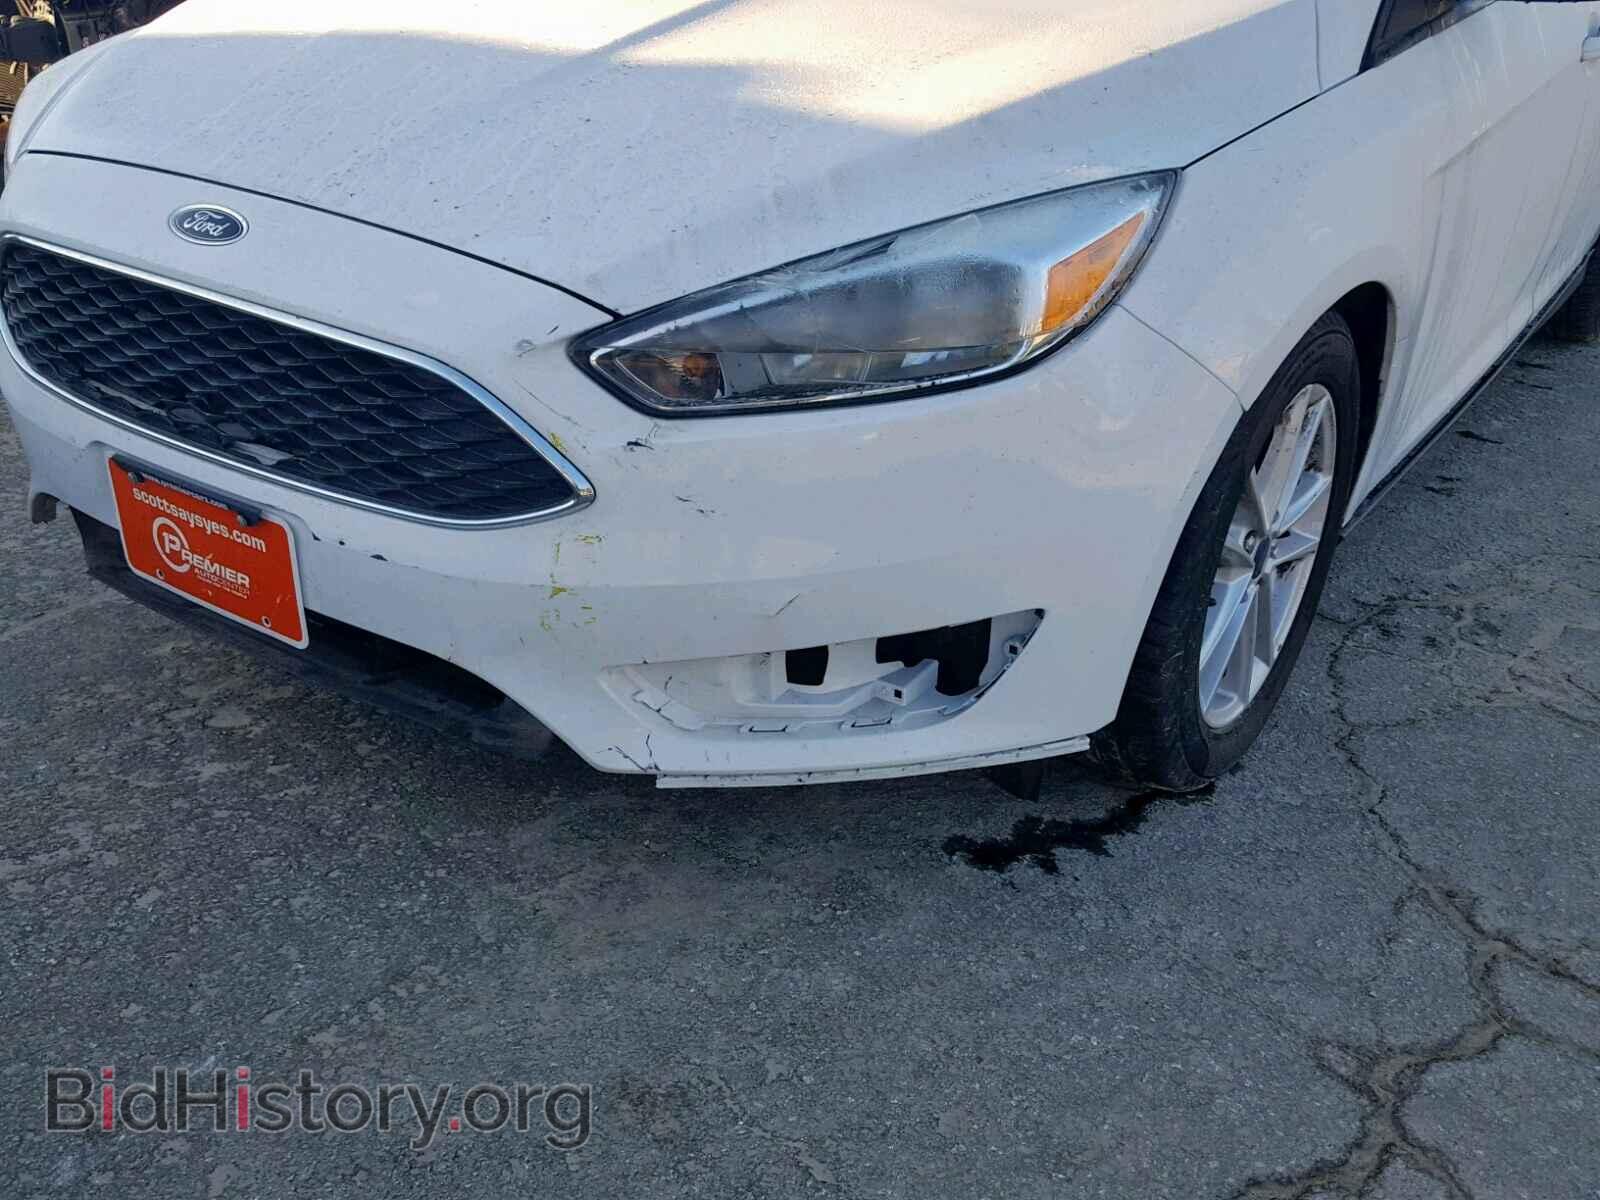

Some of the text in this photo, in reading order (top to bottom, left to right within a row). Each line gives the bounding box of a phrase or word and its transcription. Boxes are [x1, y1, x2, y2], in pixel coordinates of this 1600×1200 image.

[183, 210, 232, 237] Ford
[131, 487, 267, 553] scottsaysyes.com
[161, 531, 251, 590] PREMIER
